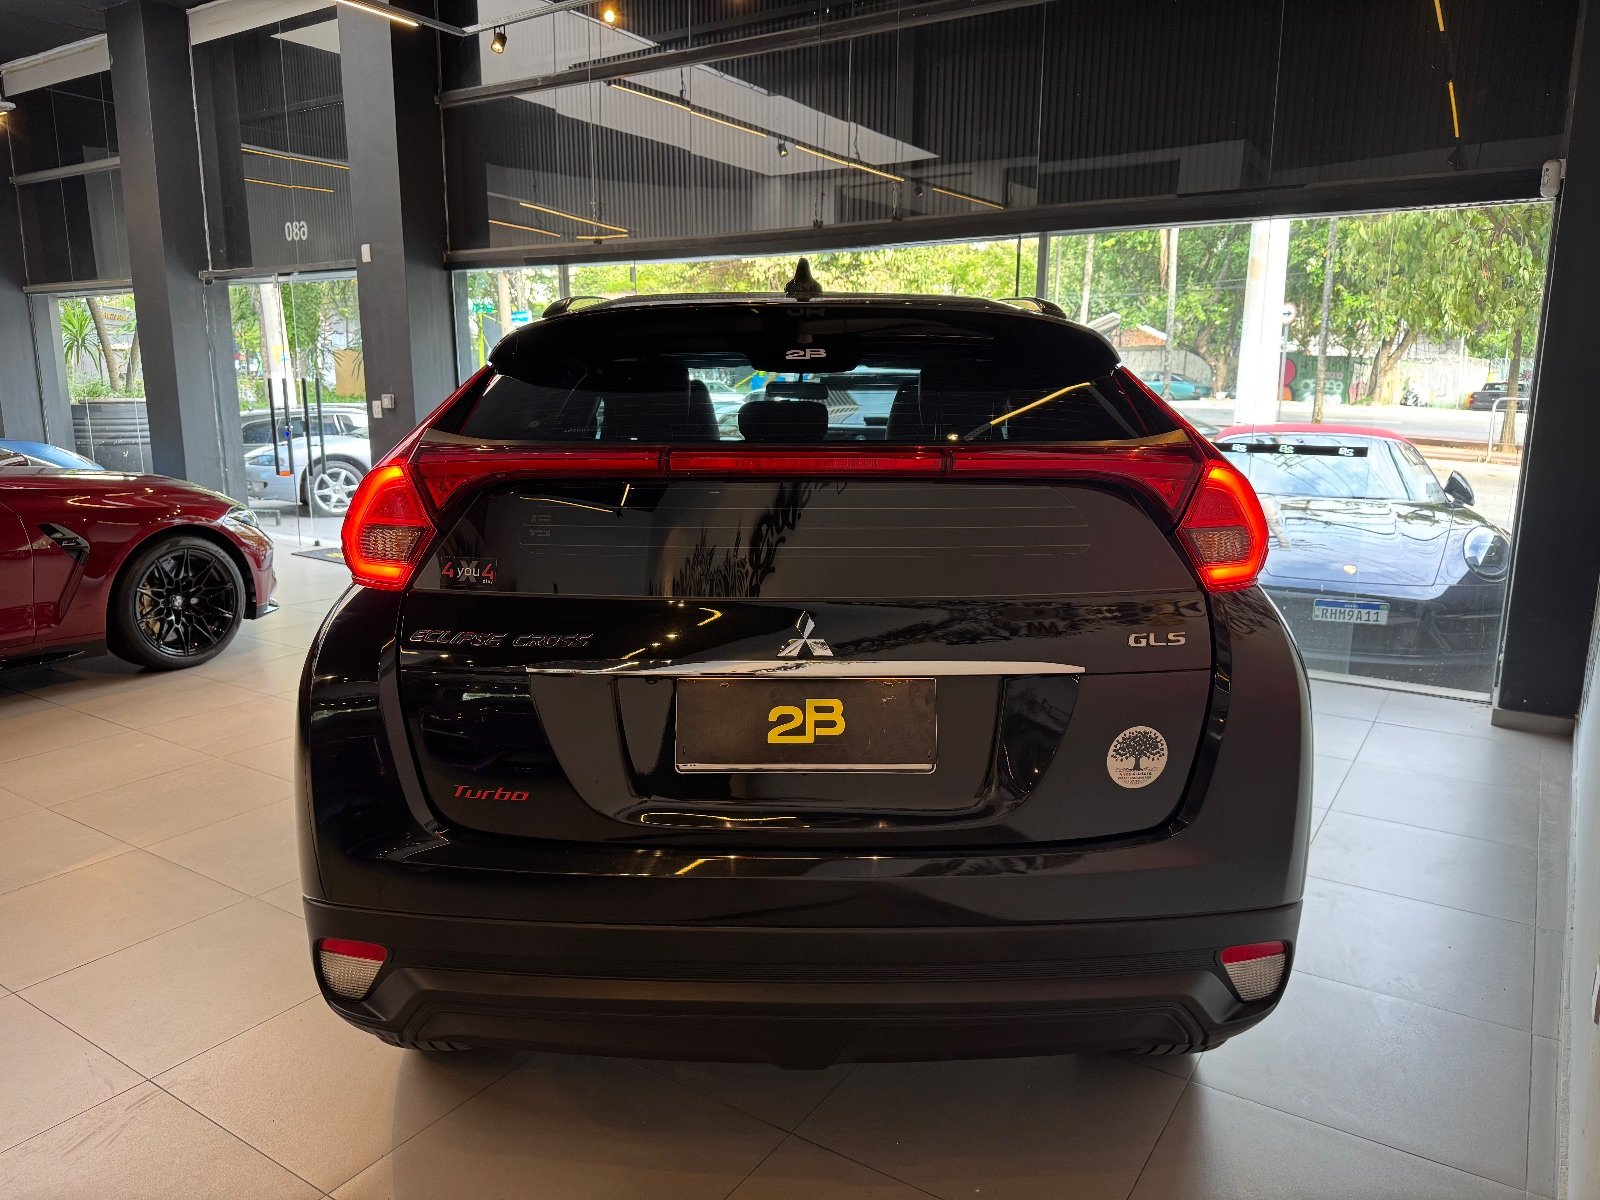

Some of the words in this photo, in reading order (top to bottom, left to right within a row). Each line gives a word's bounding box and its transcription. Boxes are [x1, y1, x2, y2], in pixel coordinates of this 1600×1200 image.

[785, 348, 827, 360] 2B
[1320, 607, 1380, 623] RHM9A11
[409, 629, 507, 648] ECLIPSE
[512, 633, 594, 648] CROSS
[1128, 631, 1186, 647] GLS
[767, 698, 846, 744] 2B
[454, 784, 530, 801] Turbo
